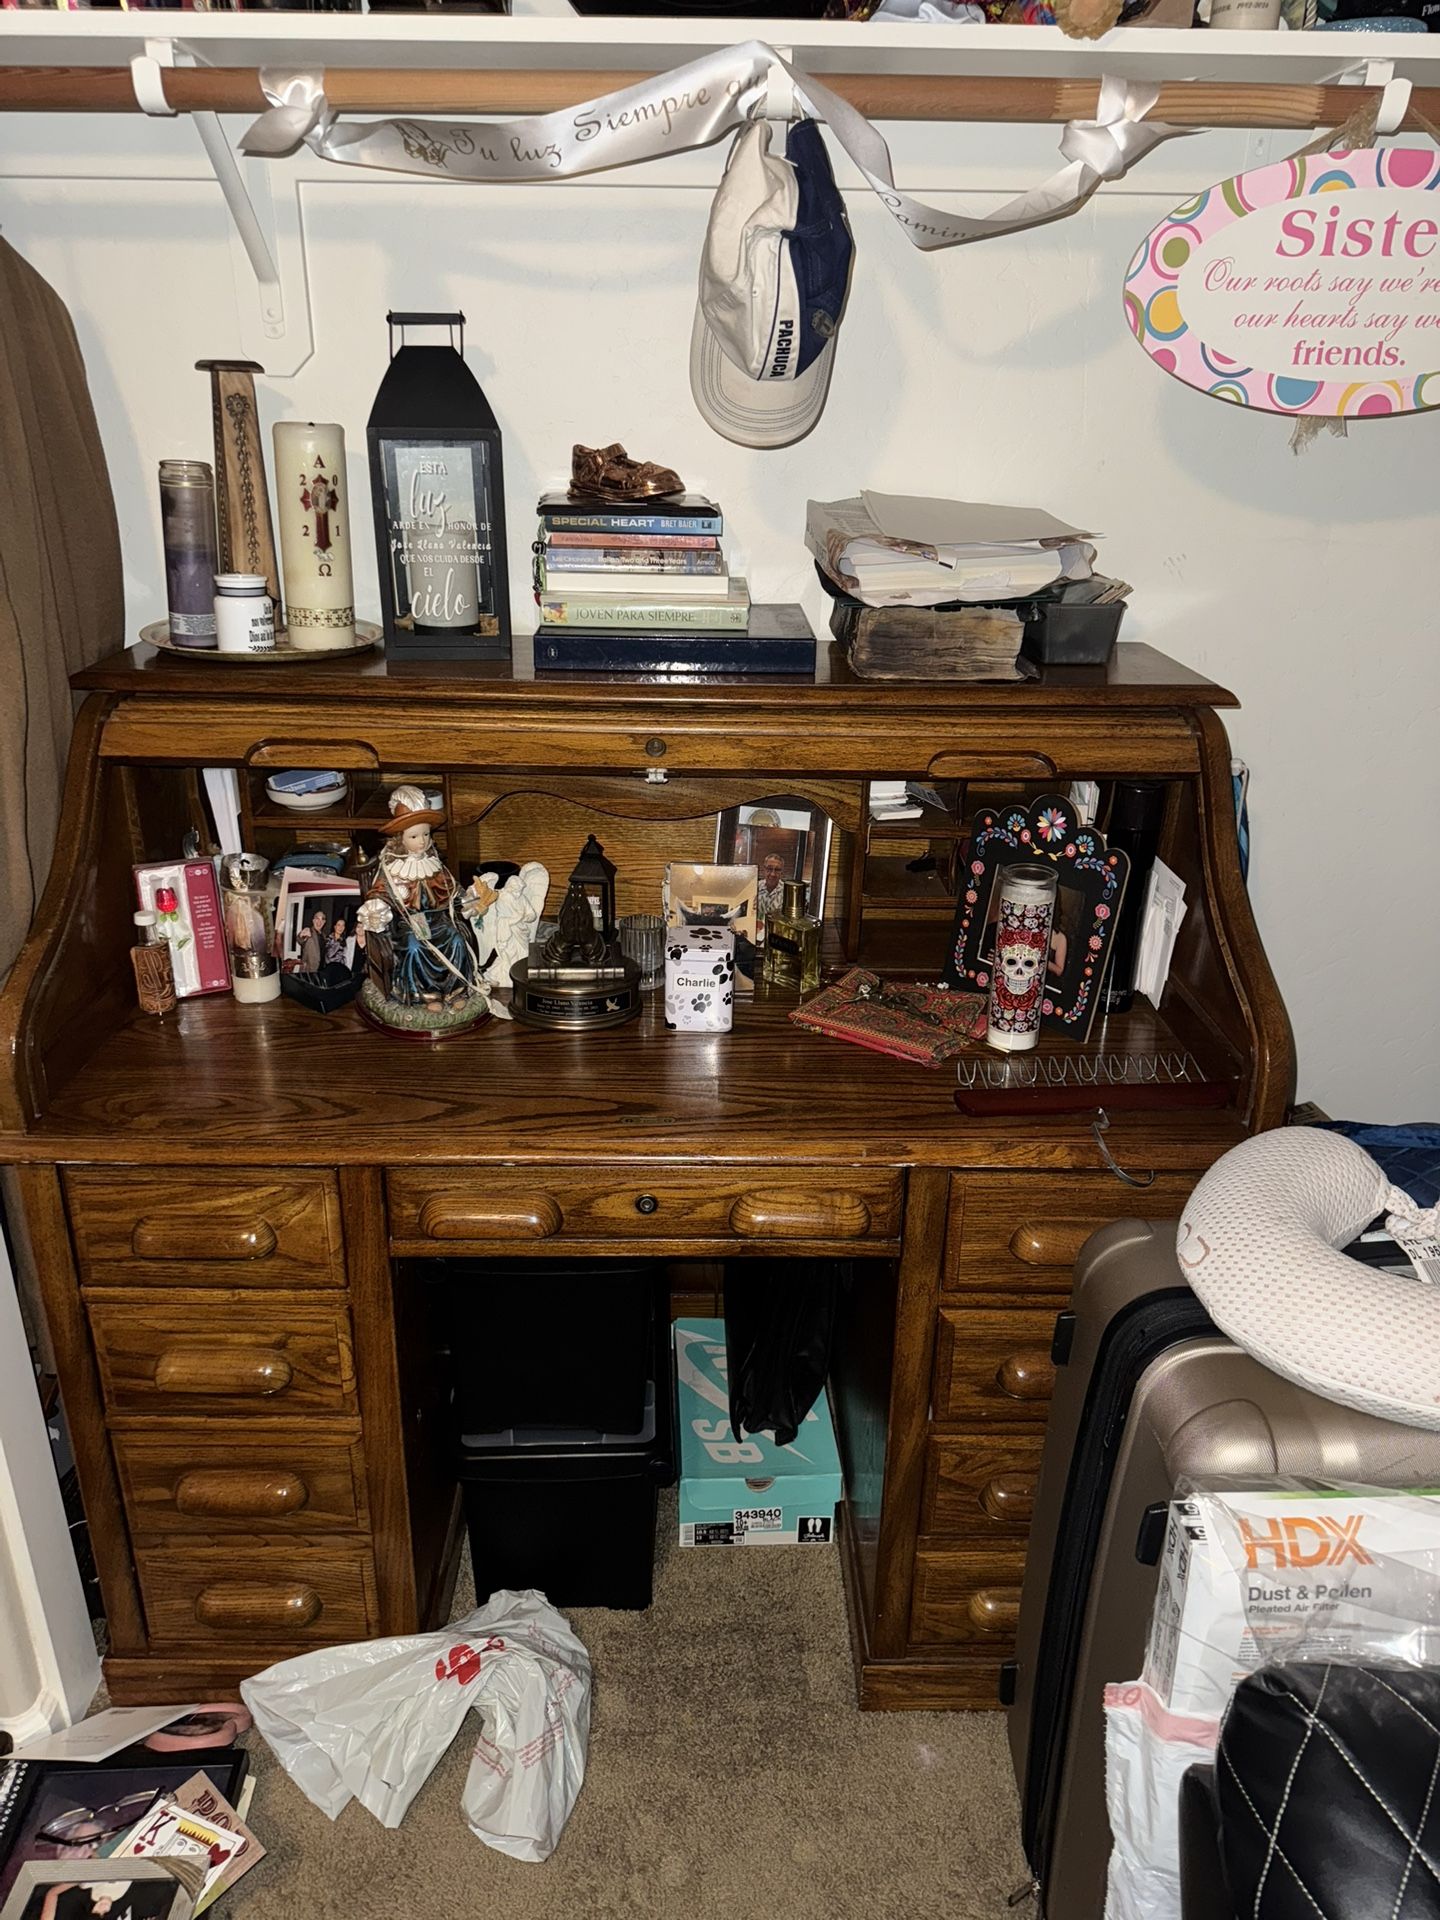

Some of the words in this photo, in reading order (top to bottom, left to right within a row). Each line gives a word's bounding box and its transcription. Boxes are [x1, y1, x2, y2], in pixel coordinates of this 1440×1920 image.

[447, 128, 500, 162] Tu
[510, 136, 563, 167] luz
[573, 88, 711, 141] Siempre
[1275, 205, 1440, 258] Siste
[1203, 257, 1257, 292] Our
[1264, 268, 1323, 291] roots
[1328, 276, 1373, 306] say
[1233, 311, 1279, 329] our
[1282, 300, 1358, 329] hearts
[1363, 312, 1410, 342] say
[769, 319, 794, 378] PACHUCA
[1291, 340, 1406, 366] friends.
[313, 454, 326, 469] A
[419, 461, 447, 474] ESTA
[298, 474, 307, 487] 2
[331, 474, 339, 487] 0
[410, 469, 448, 537] luz
[447, 522, 478, 531] HONOR
[480, 523, 492, 531] DE
[551, 517, 607, 527] SPECIAL
[610, 518, 655, 528] HEART
[660, 519, 677, 528] BRET
[677, 519, 698, 528] BAIER
[302, 525, 310, 537] 2
[335, 525, 341, 537] 1
[417, 554, 434, 563] NOS
[434, 555, 459, 564] CUIDA
[460, 555, 485, 564] DESDE
[423, 567, 434, 577] EL
[411, 567, 471, 621] cielo
[575, 607, 614, 620] JOVEN
[616, 609, 645, 621] PARA
[648, 609, 695, 622] SIEMPRE
[676, 977, 716, 988] Charlie
[691, 1419, 764, 1464] SB
[735, 1508, 782, 1520] 343940
[1238, 1515, 1376, 1569] HDX
[1248, 1586, 1292, 1602] Dust
[1296, 1585, 1310, 1601] &
[1249, 1604, 1291, 1614] Pleated
[1294, 1603, 1310, 1612] Air
[1313, 1602, 1340, 1612] Filter
[139, 1809, 178, 1847] K
